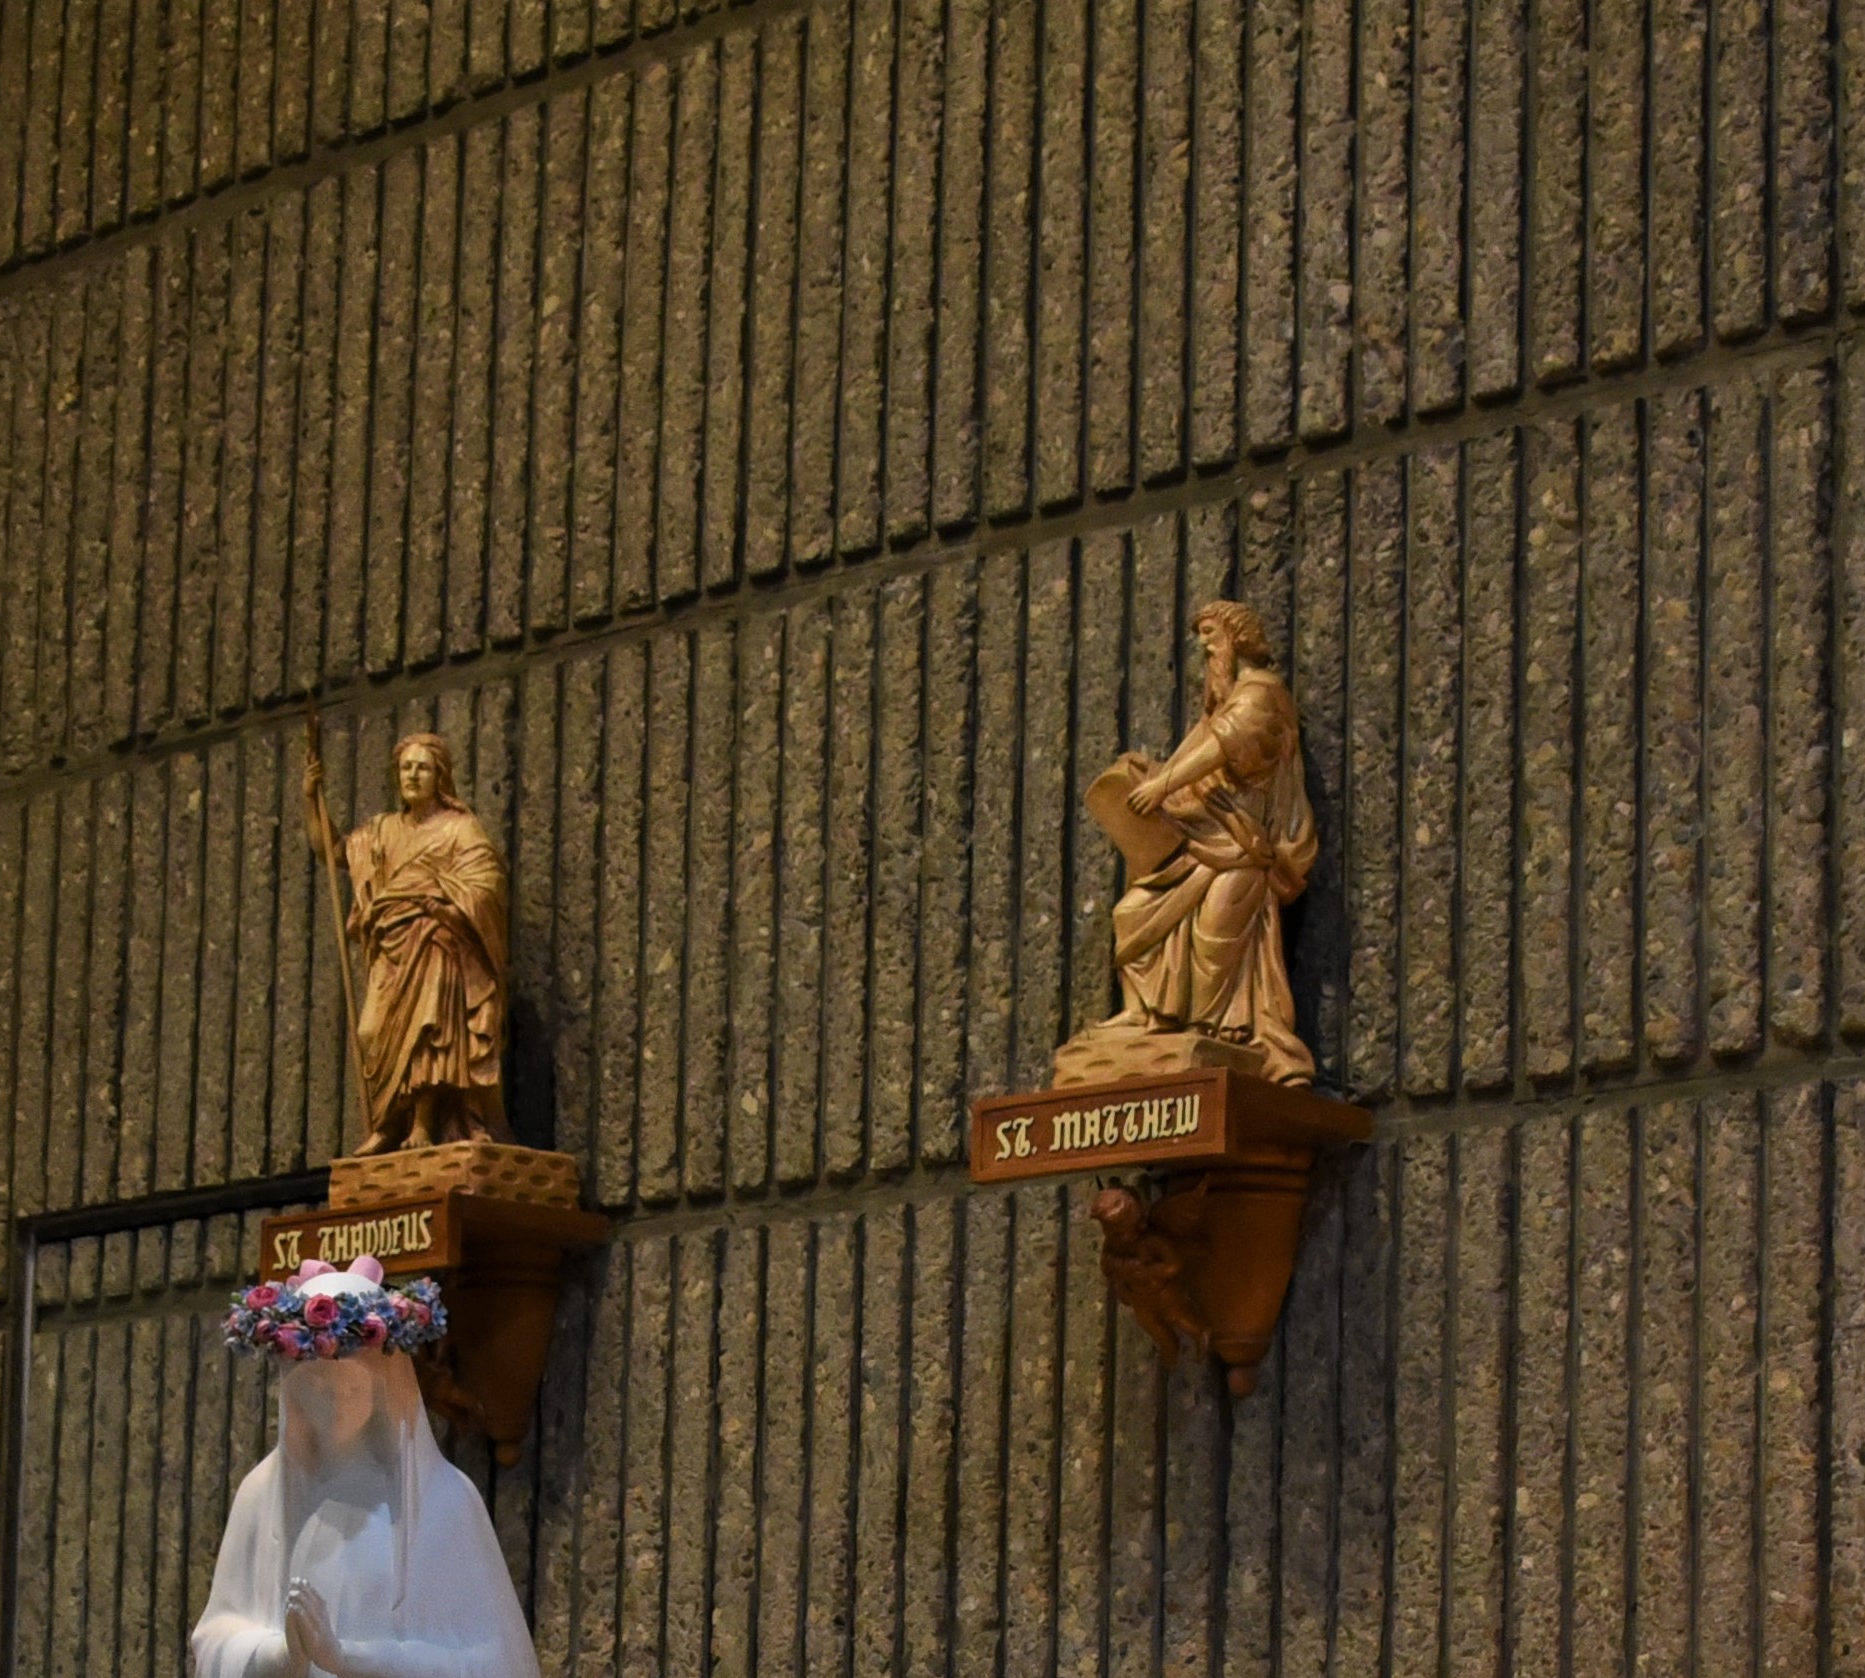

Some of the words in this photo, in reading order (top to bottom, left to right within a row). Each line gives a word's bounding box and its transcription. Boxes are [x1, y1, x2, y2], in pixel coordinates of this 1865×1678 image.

[994, 1116, 1038, 1161] ST.
[1048, 1093, 1201, 1152] MATTHEW
[317, 1209, 433, 1264] THADDEUS
